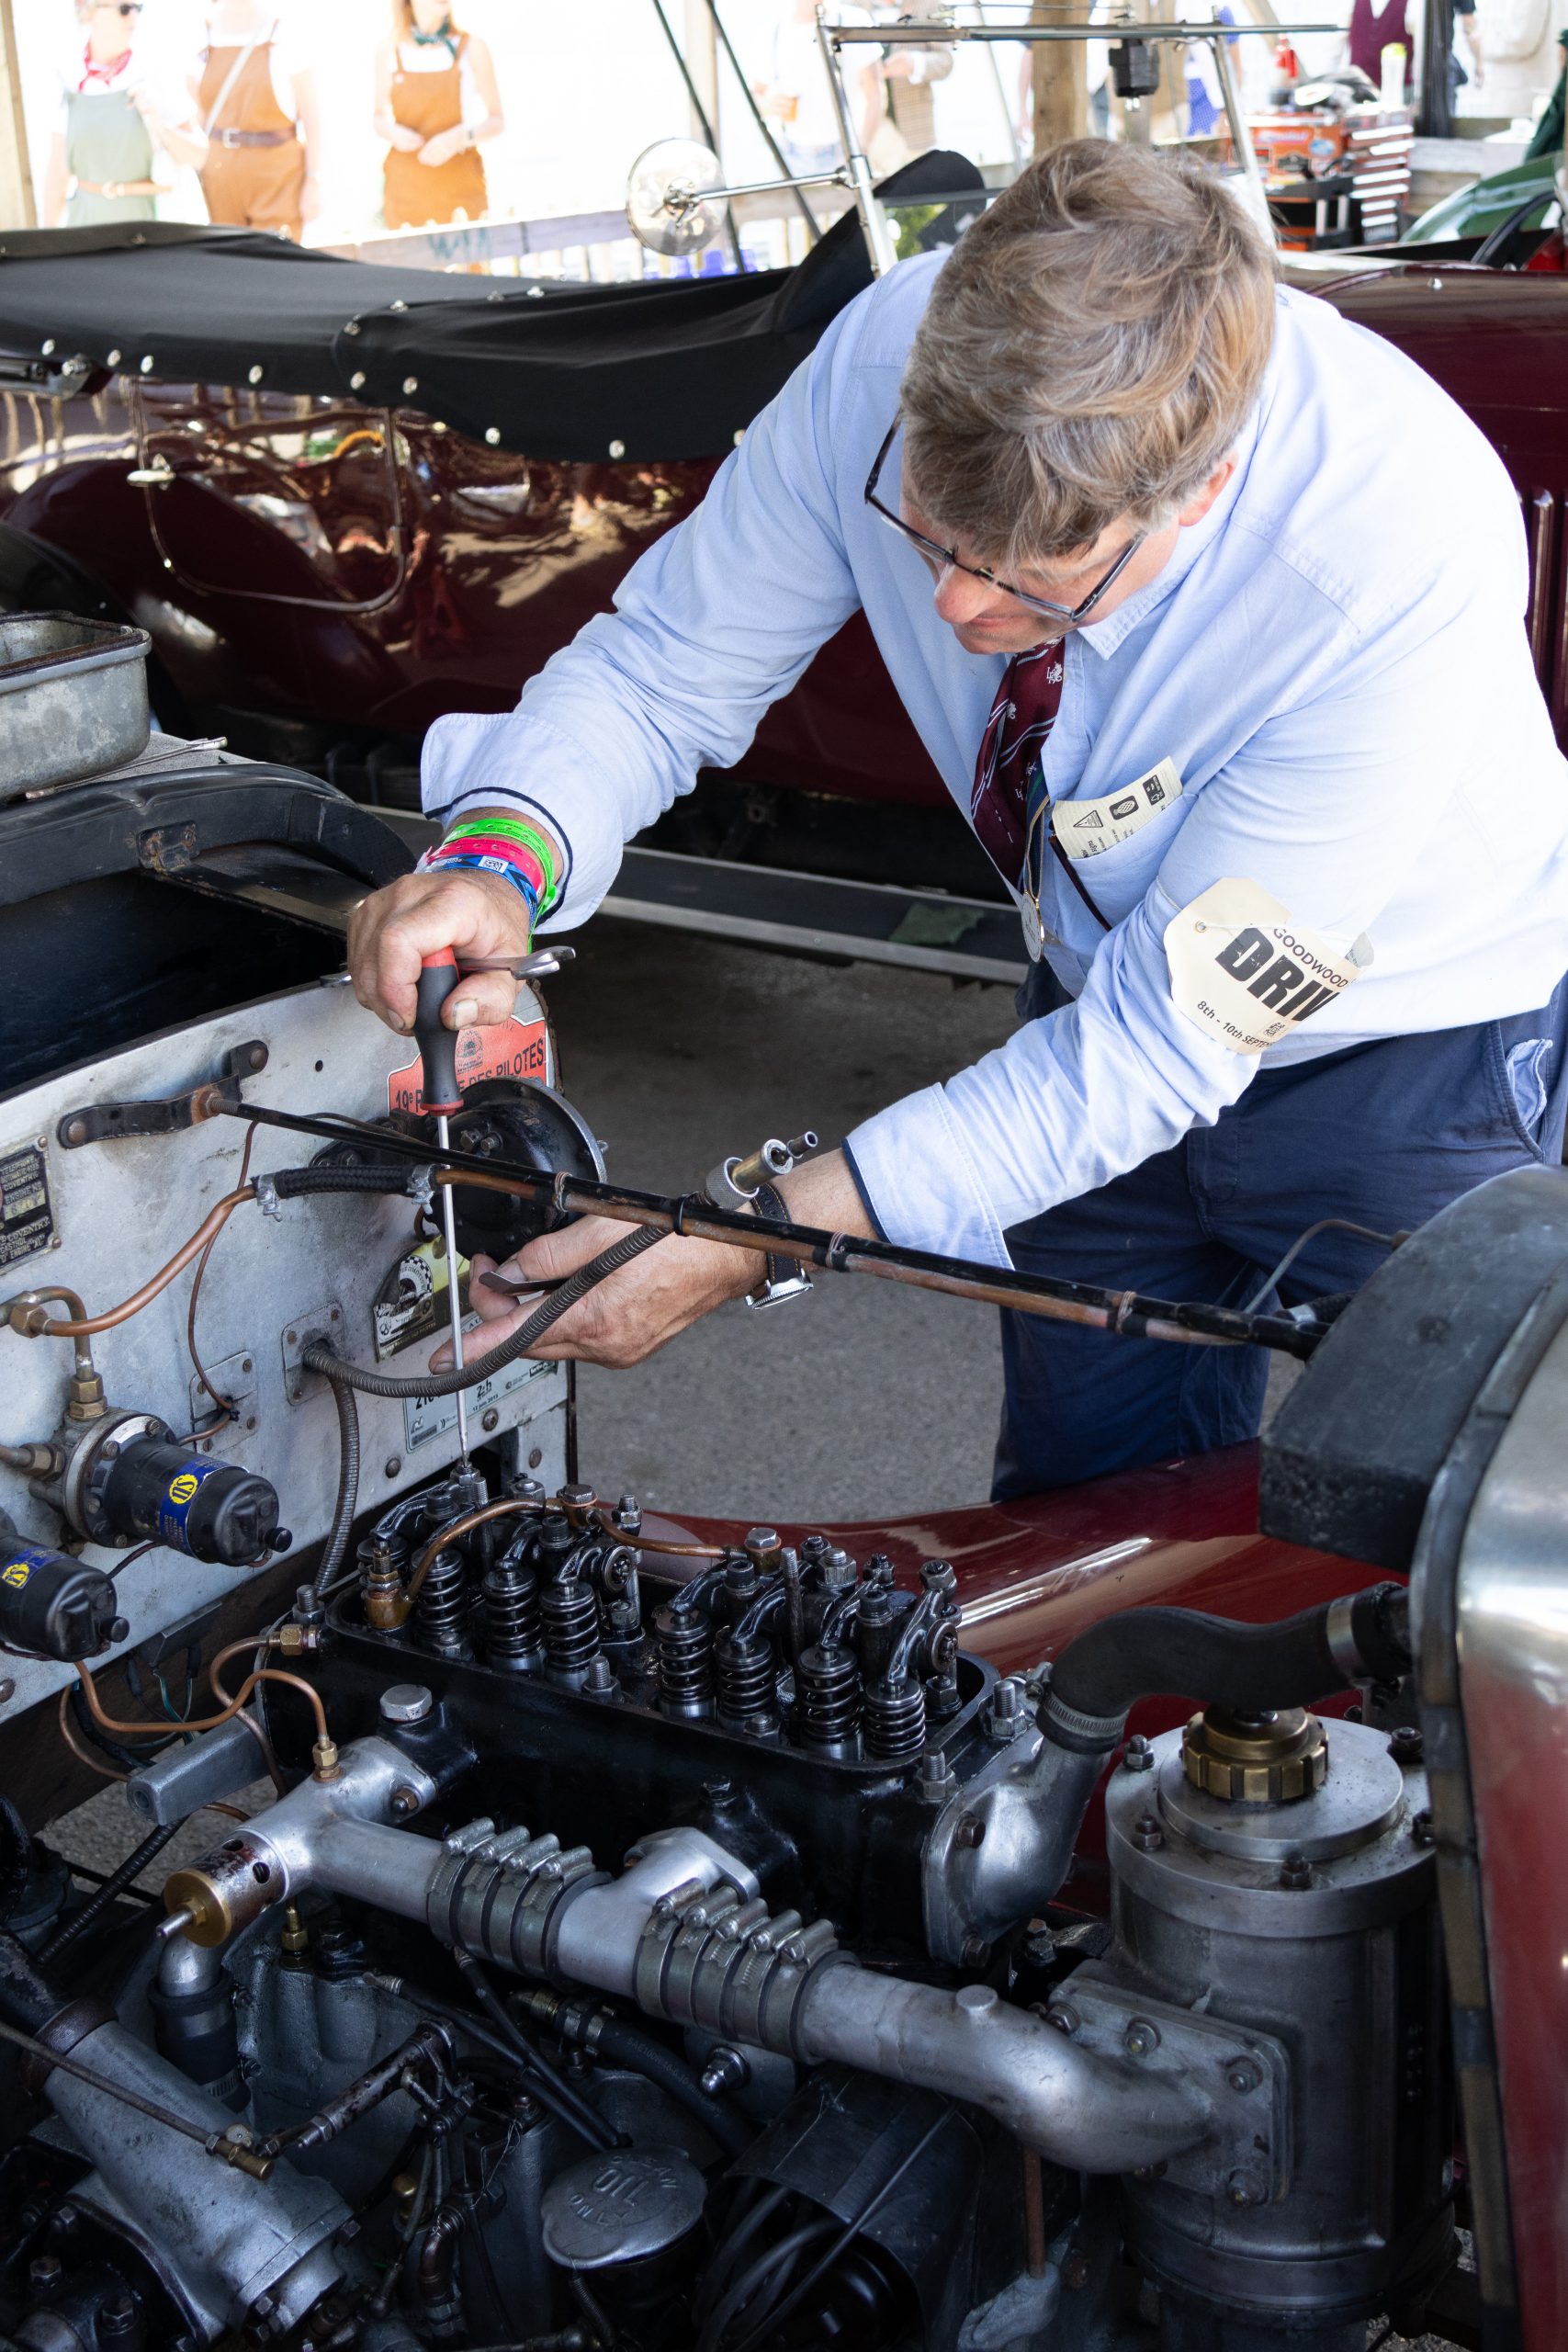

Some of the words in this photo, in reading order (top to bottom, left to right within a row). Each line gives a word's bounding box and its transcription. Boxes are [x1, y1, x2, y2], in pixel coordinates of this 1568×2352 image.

[1273, 928, 1348, 988] GOODWOOD
[1197, 1000, 1215, 1019] 8th
[1223, 1022, 1243, 1039] 10th
[496, 1037, 545, 1079] PILOTES
[172, 1476, 196, 1502] SU
[592, 2167, 650, 2208] OIL
[570, 2194, 630, 2228] ONLY
